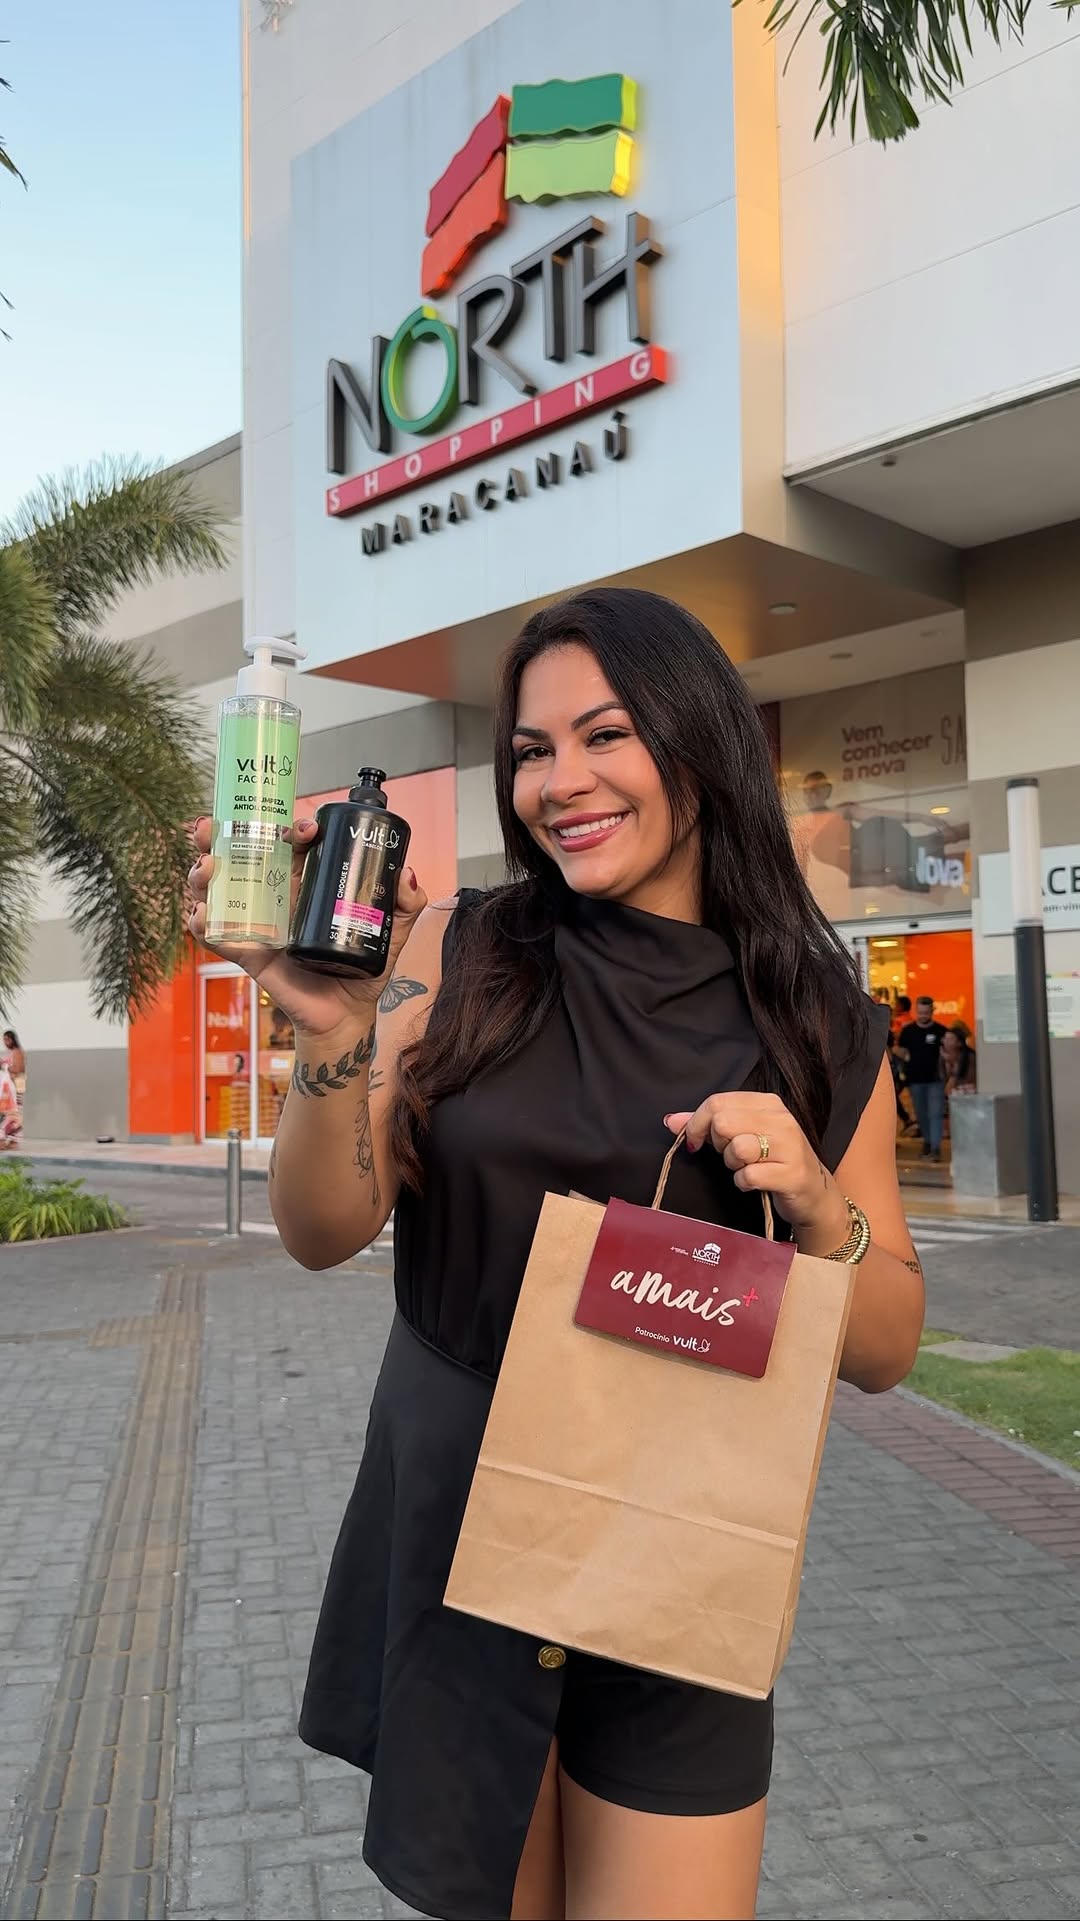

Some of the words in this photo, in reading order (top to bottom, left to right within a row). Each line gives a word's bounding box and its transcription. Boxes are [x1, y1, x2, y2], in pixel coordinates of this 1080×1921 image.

[327, 212, 663, 474] NORTH
[328, 354, 650, 512] SHOPPING
[361, 410, 629, 556] MARACANAÚ
[841, 724, 883, 743] Vem
[842, 734, 933, 763] conhecer
[236, 754, 276, 774] vult
[842, 767, 854, 781] a
[857, 758, 906, 779] nova
[349, 825, 385, 846] vult
[336, 871, 349, 898] CHOQUE
[343, 861, 350, 871] DE
[1041, 865, 1080, 896] CE
[227, 900, 241, 908] 300
[241, 902, 247, 910] g
[1043, 901, 1080, 913] em-vin
[692, 1247, 721, 1262] NORTH
[634, 1326, 670, 1343] Patrocínio
[673, 1335, 697, 1351] vult
